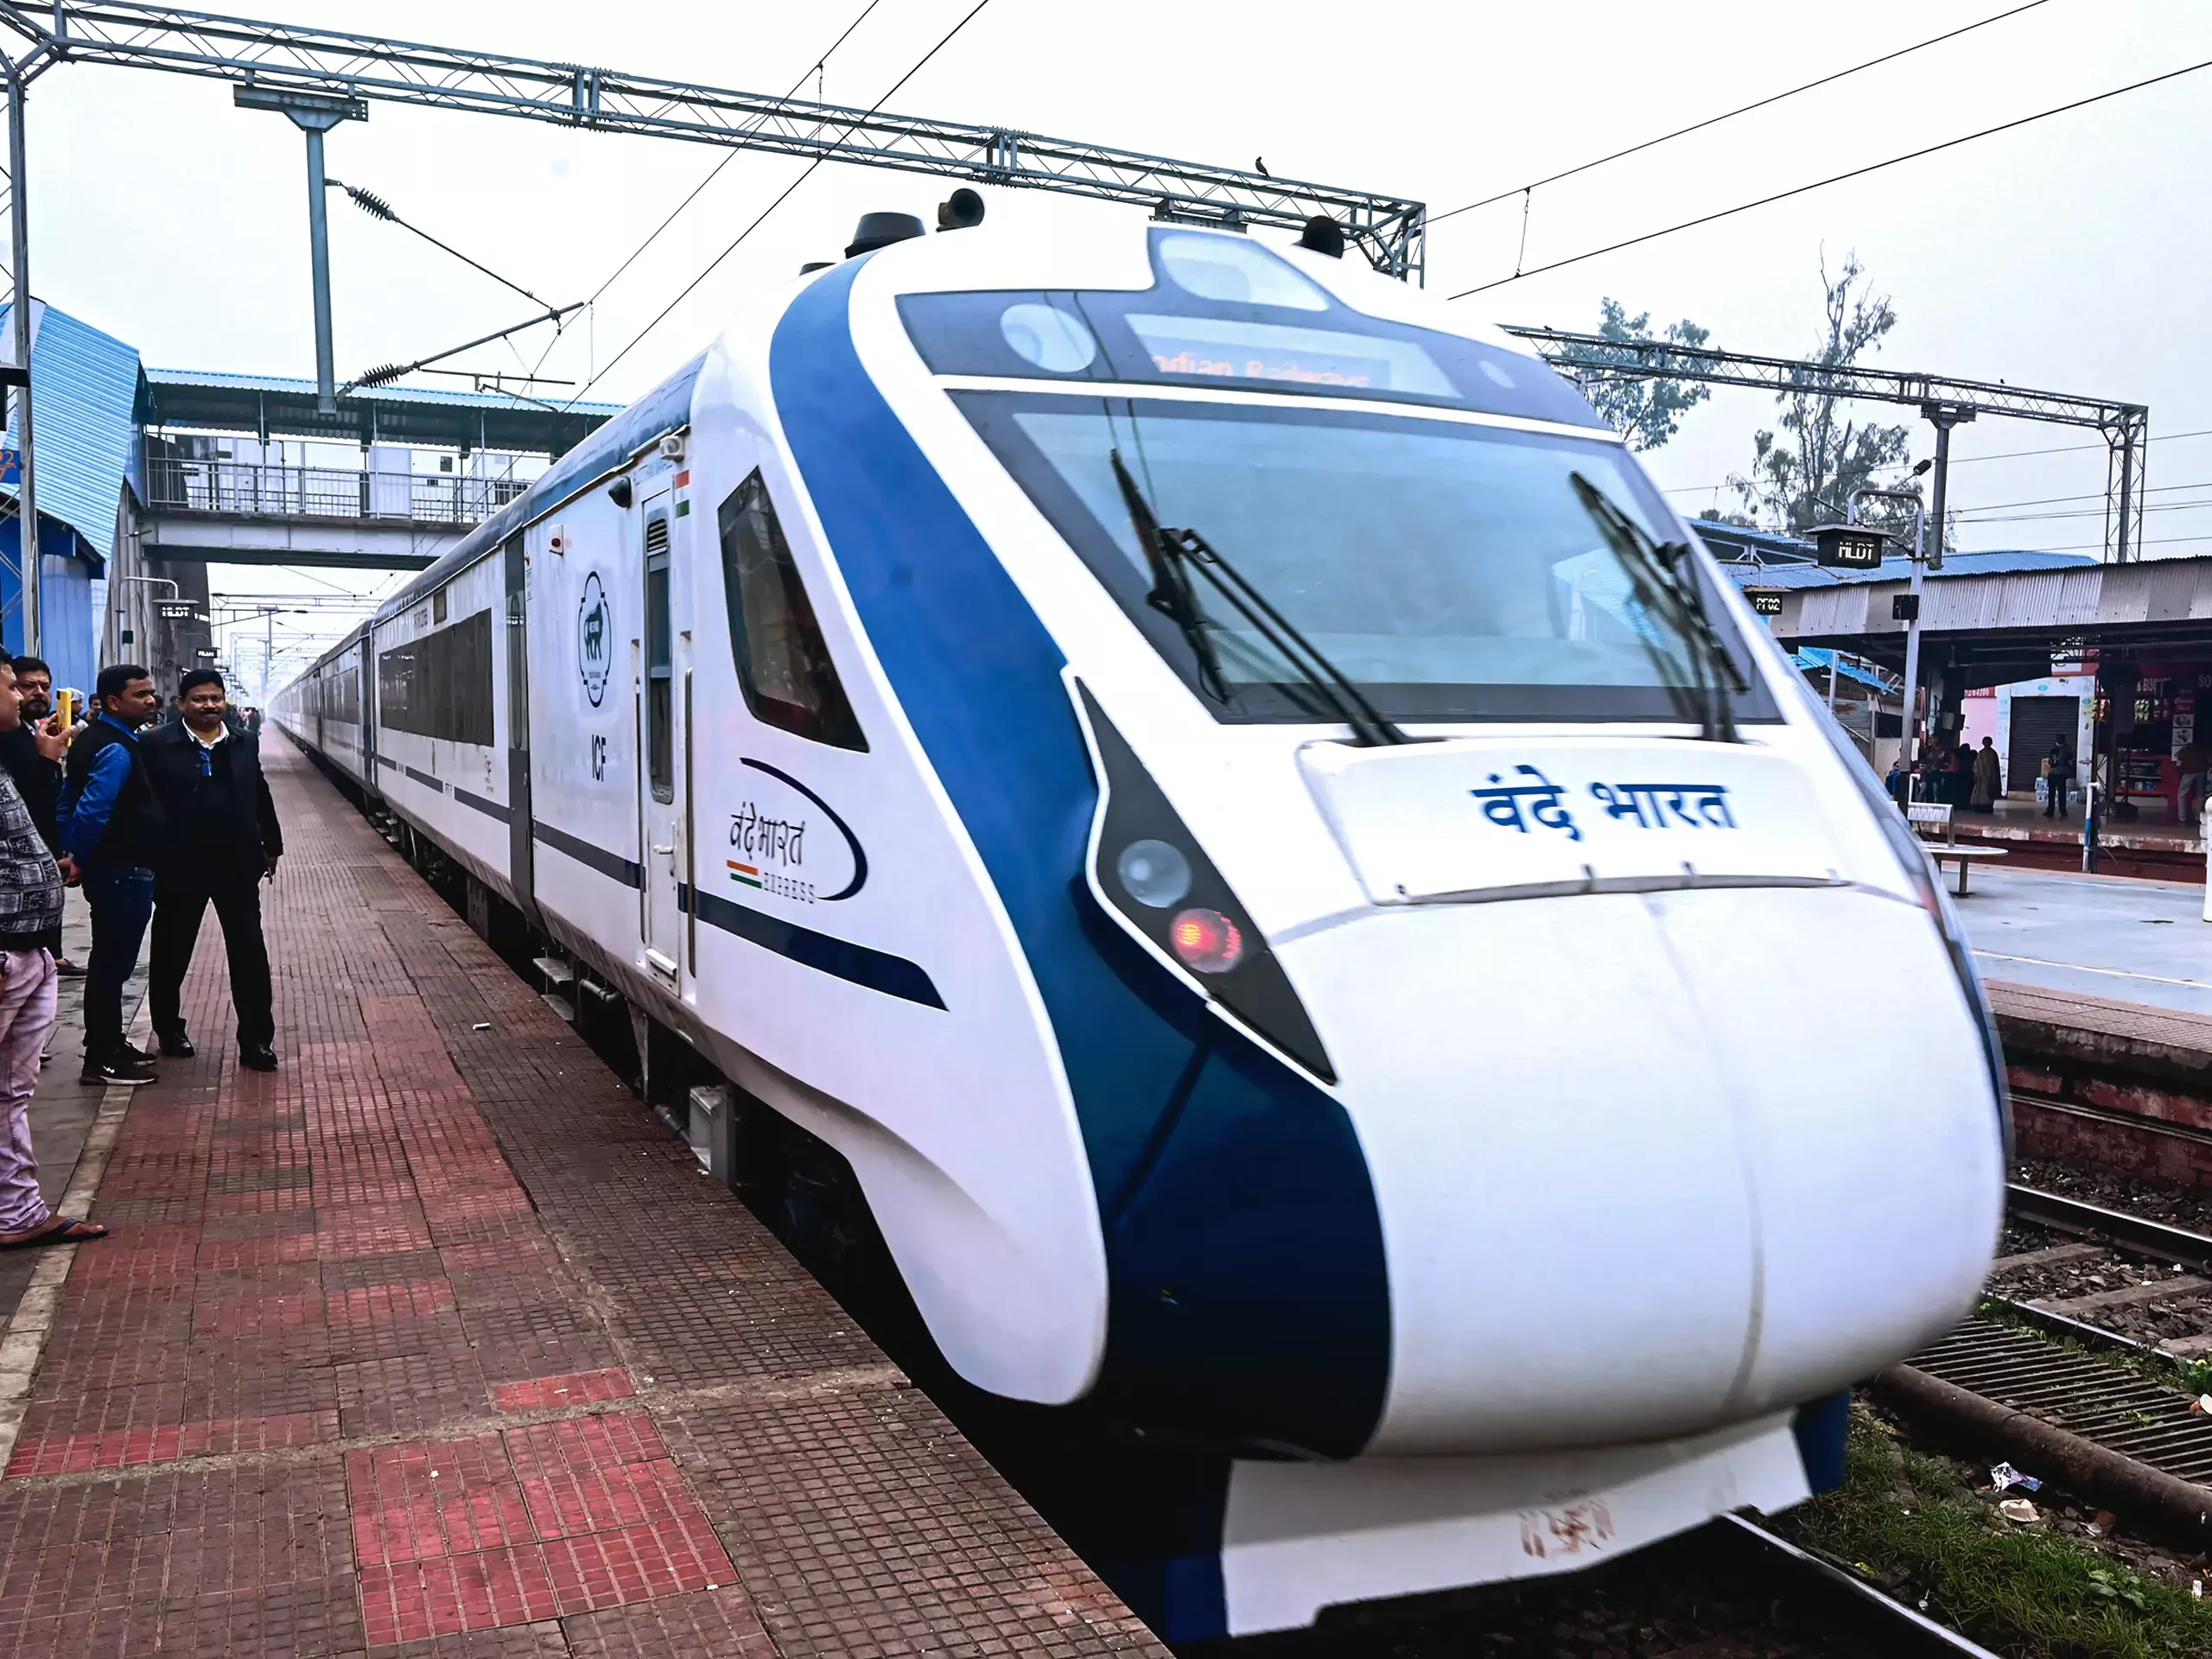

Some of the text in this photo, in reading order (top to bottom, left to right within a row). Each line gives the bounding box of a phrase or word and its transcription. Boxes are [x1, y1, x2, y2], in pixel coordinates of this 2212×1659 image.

[1151, 350, 1234, 378] ndian
[0, 450, 16, 466] 2
[1838, 541, 1874, 560] MLDT
[1756, 597, 1780, 611] PF02
[592, 734, 607, 782] ICF
[1468, 764, 1739, 842] वंदे भारत
